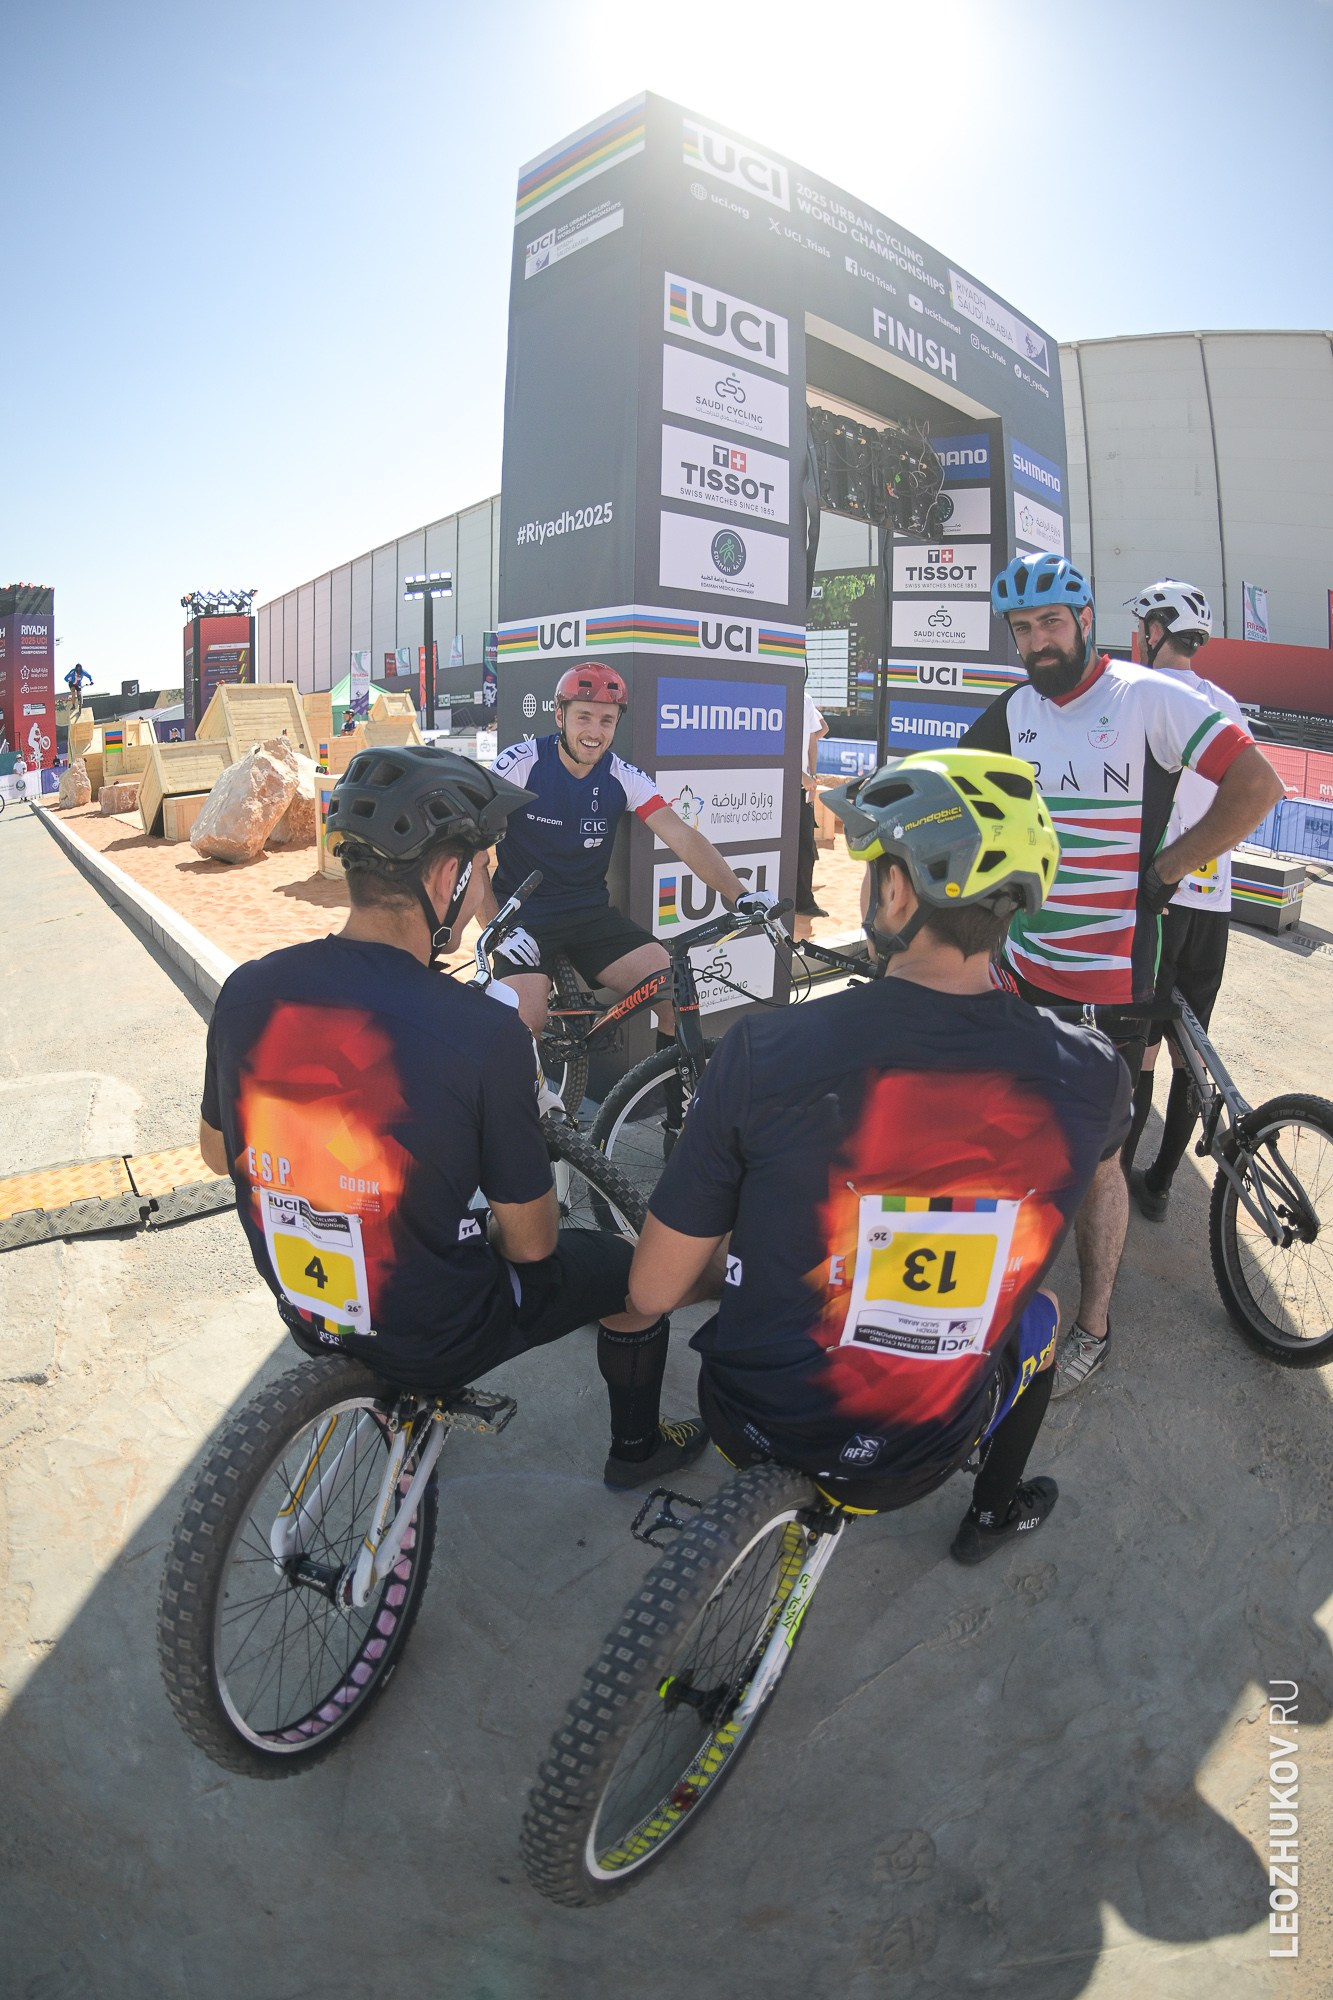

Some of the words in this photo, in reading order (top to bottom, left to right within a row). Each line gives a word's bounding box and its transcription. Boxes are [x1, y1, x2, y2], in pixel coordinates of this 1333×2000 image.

[702, 135, 783, 200] UCI
[711, 194, 750, 220] uci.org
[796, 182, 827, 208] 2025
[830, 201, 874, 235] URBAN
[876, 228, 924, 267] CYCLING
[530, 233, 554, 256] UCI
[784, 227, 831, 258] UCI_Trials
[796, 197, 848, 234] WORLD
[850, 228, 945, 295] CHAMPIONSHIPS
[860, 267, 875, 282] UCI
[876, 276, 897, 295] Trials
[956, 280, 987, 310] RIYADH
[691, 290, 776, 360] UCI
[924, 306, 961, 335] ucichannel
[957, 295, 984, 323] SAUDI
[985, 315, 1014, 342] ARABIA
[872, 307, 957, 382] FINISH
[695, 396, 724, 411] SAUDI
[726, 405, 763, 424] CYCLING
[935, 449, 987, 467] MANO
[680, 461, 775, 504] TISSOT
[1012, 453, 1060, 493] SHIMANO
[680, 487, 702, 499] SWISS
[704, 492, 738, 507] WATCHES
[739, 501, 759, 513] SINCE
[760, 506, 775, 516] 1853
[517, 502, 613, 545] #Riyadh2025
[713, 550, 731, 573] EDAMAH
[905, 566, 977, 581] TISSOT
[718, 584, 736, 592] MEDICAL
[21, 625, 48, 636] RIYADH
[21, 636, 36, 645] 2025
[539, 620, 580, 651] UCI
[701, 620, 752, 653] UCI
[936, 631, 966, 639] CYCLING
[919, 665, 958, 686] UCI
[660, 703, 783, 732] SHIMANO
[890, 716, 971, 739] SHIMAN
[711, 792, 747, 810] الرياضة
[750, 792, 773, 809] وزارة
[583, 821, 606, 832] CIC
[710, 812, 741, 825] Ministry
[741, 810, 751, 822] of
[751, 810, 773, 823] Sport
[1310, 820, 1333, 835] UCI
[452, 861, 473, 902] LAZER
[247, 1145, 291, 1185] ESP
[339, 1175, 380, 1196] GOBIK
[273, 1196, 298, 1212] UCI
[305, 1256, 328, 1289] 4
[902, 1247, 957, 1294] 13
[898, 1317, 921, 1326] ARABIA
[916, 1327, 938, 1335] RIYADH
[858, 1327, 912, 1342] CHAMPIONSHIPS
[869, 1335, 896, 1345] CYCLING
[896, 1341, 920, 1350] URBAN
[912, 1337, 937, 1345] WORLD
[941, 1338, 968, 1352] UCI
